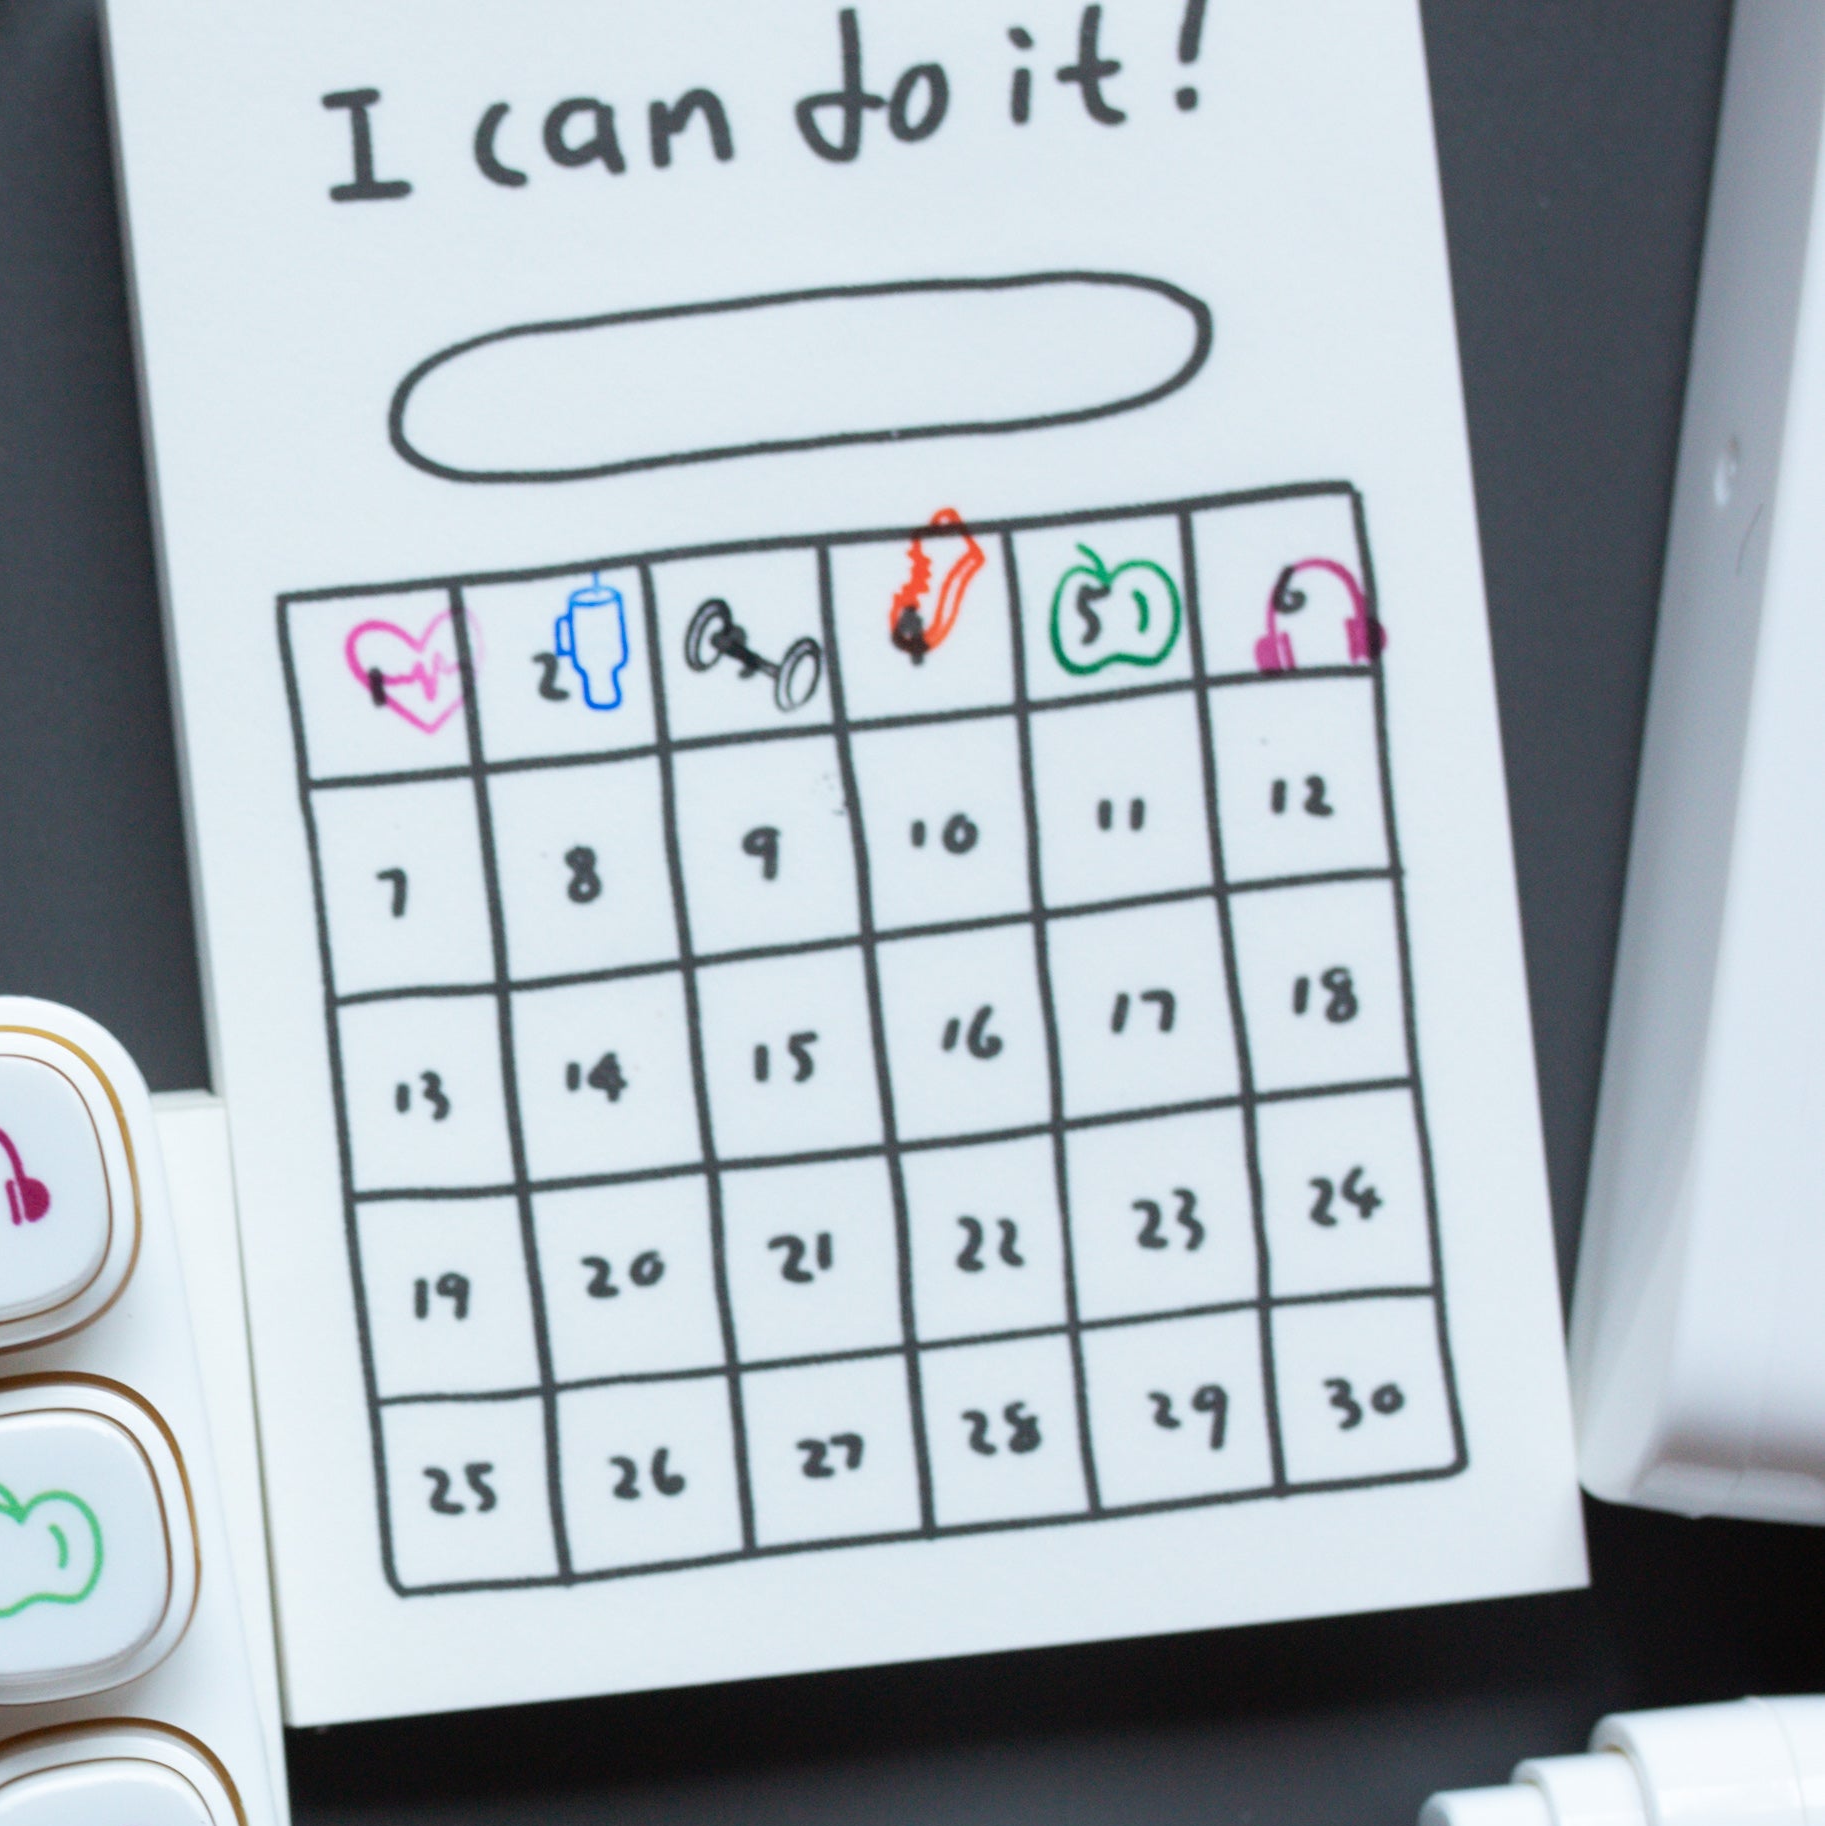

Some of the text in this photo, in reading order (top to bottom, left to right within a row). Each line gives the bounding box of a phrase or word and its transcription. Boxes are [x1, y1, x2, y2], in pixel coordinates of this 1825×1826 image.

[320, 0, 1209, 204] I can do it!
[532, 651, 571, 703] 2
[1075, 584, 1112, 646] 5
[376, 774, 1335, 919] 7 8 9 10 11 12
[394, 965, 1360, 1122] 13 14 15 16 17 18
[413, 1165, 1383, 1321] 19 20 21 22 23 24
[422, 1377, 1406, 1517] 25 26 27 28 29 30
